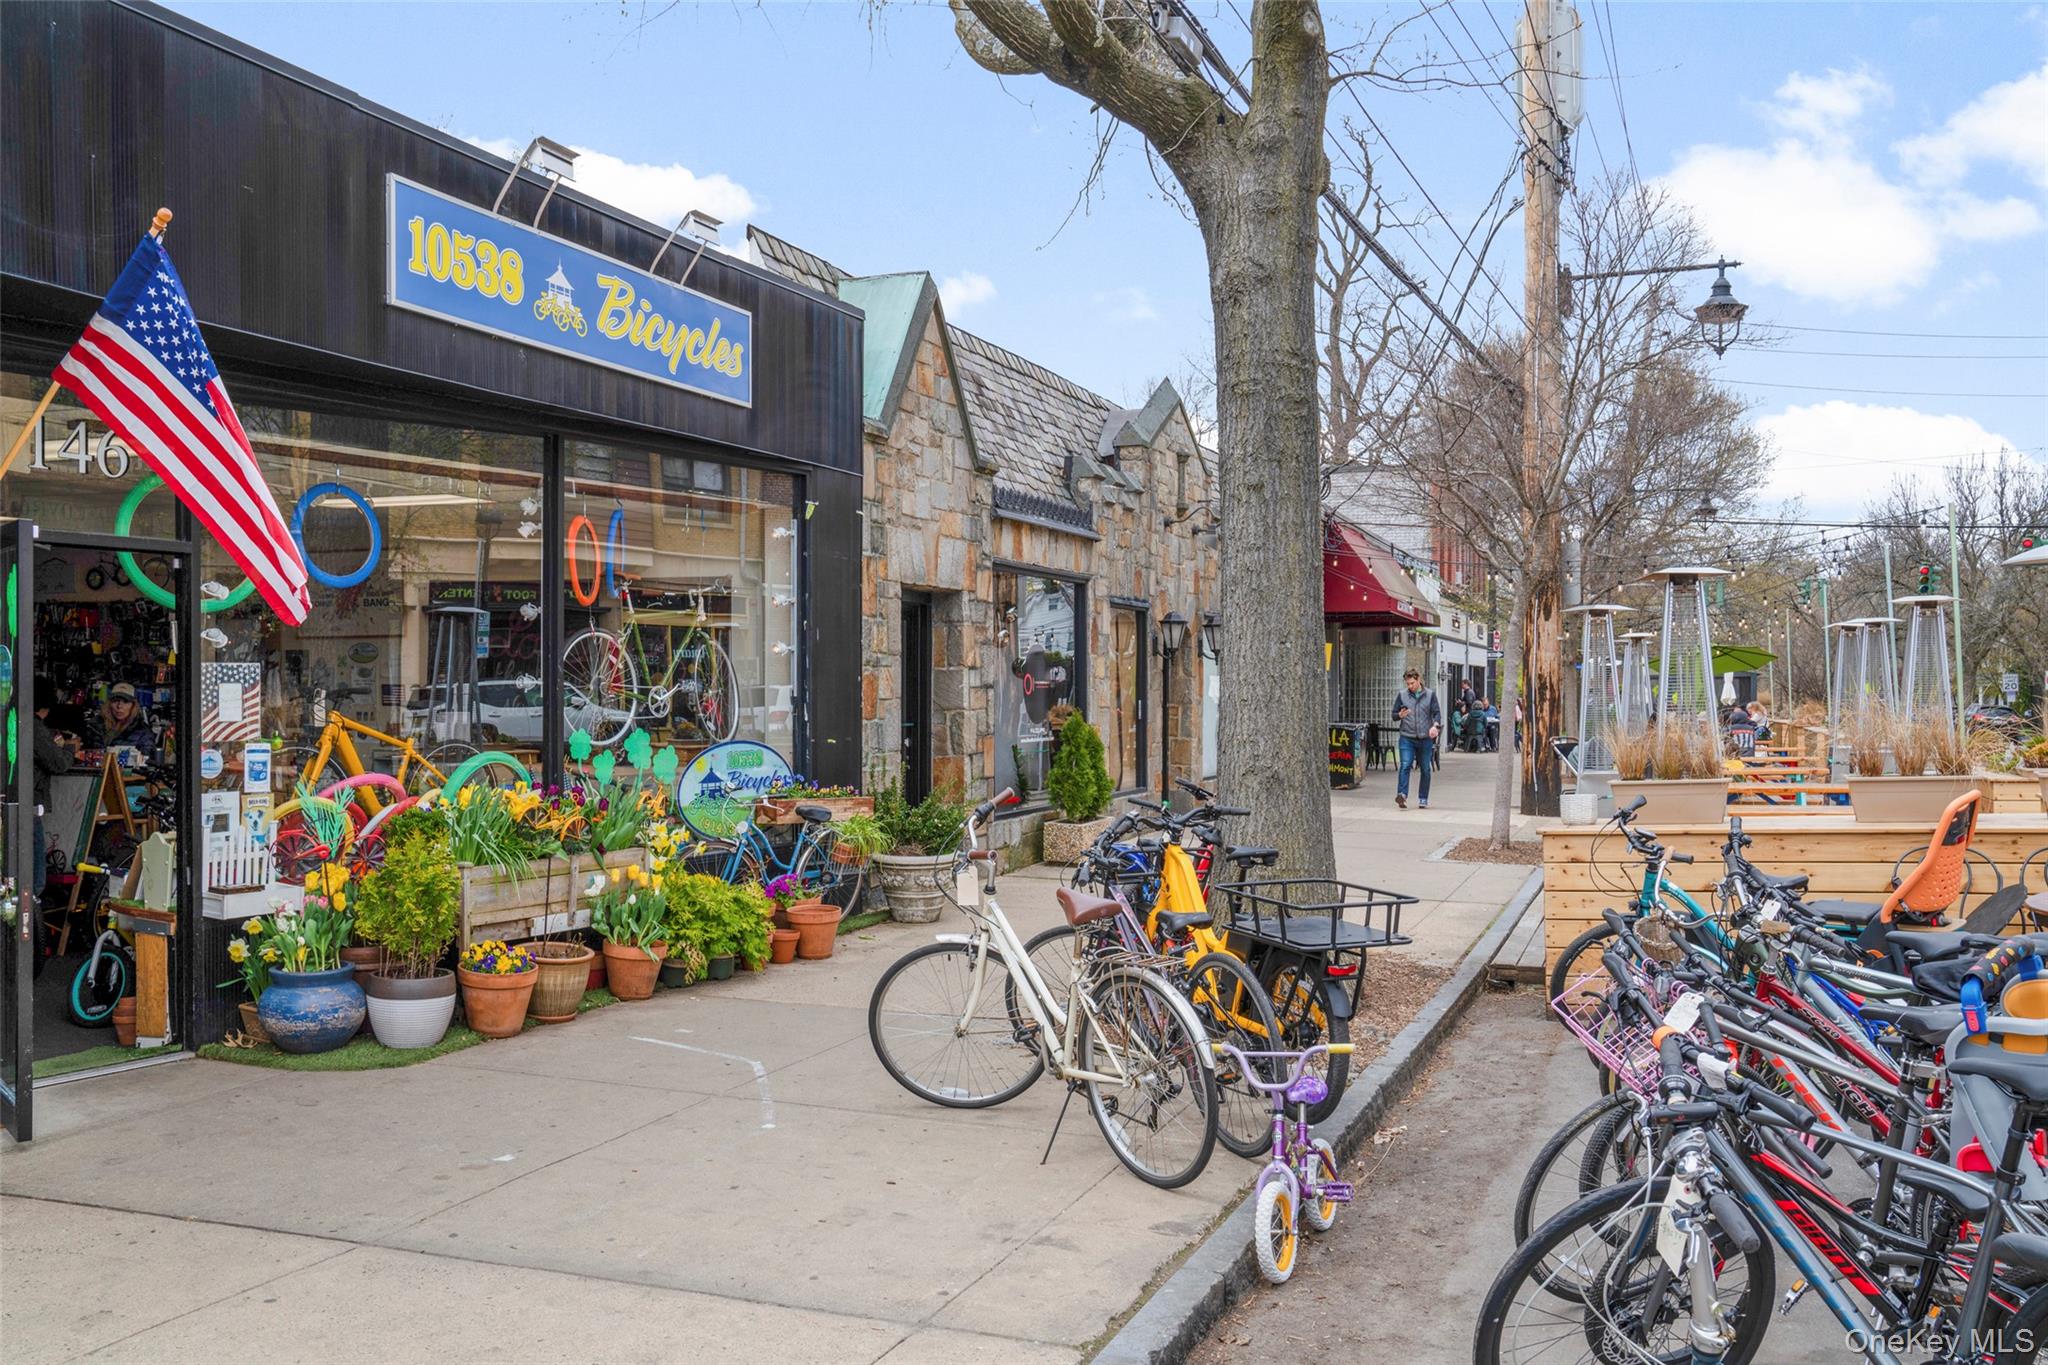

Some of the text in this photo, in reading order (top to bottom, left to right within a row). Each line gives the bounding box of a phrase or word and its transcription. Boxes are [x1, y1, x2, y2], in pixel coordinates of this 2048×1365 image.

[408, 215, 744, 378] 10538 Bicycles
[29, 416, 131, 480] 146
[2004, 682, 2017, 690] 20
[1328, 729, 1350, 746] LA
[1770, 1053, 1842, 1132] TREK
